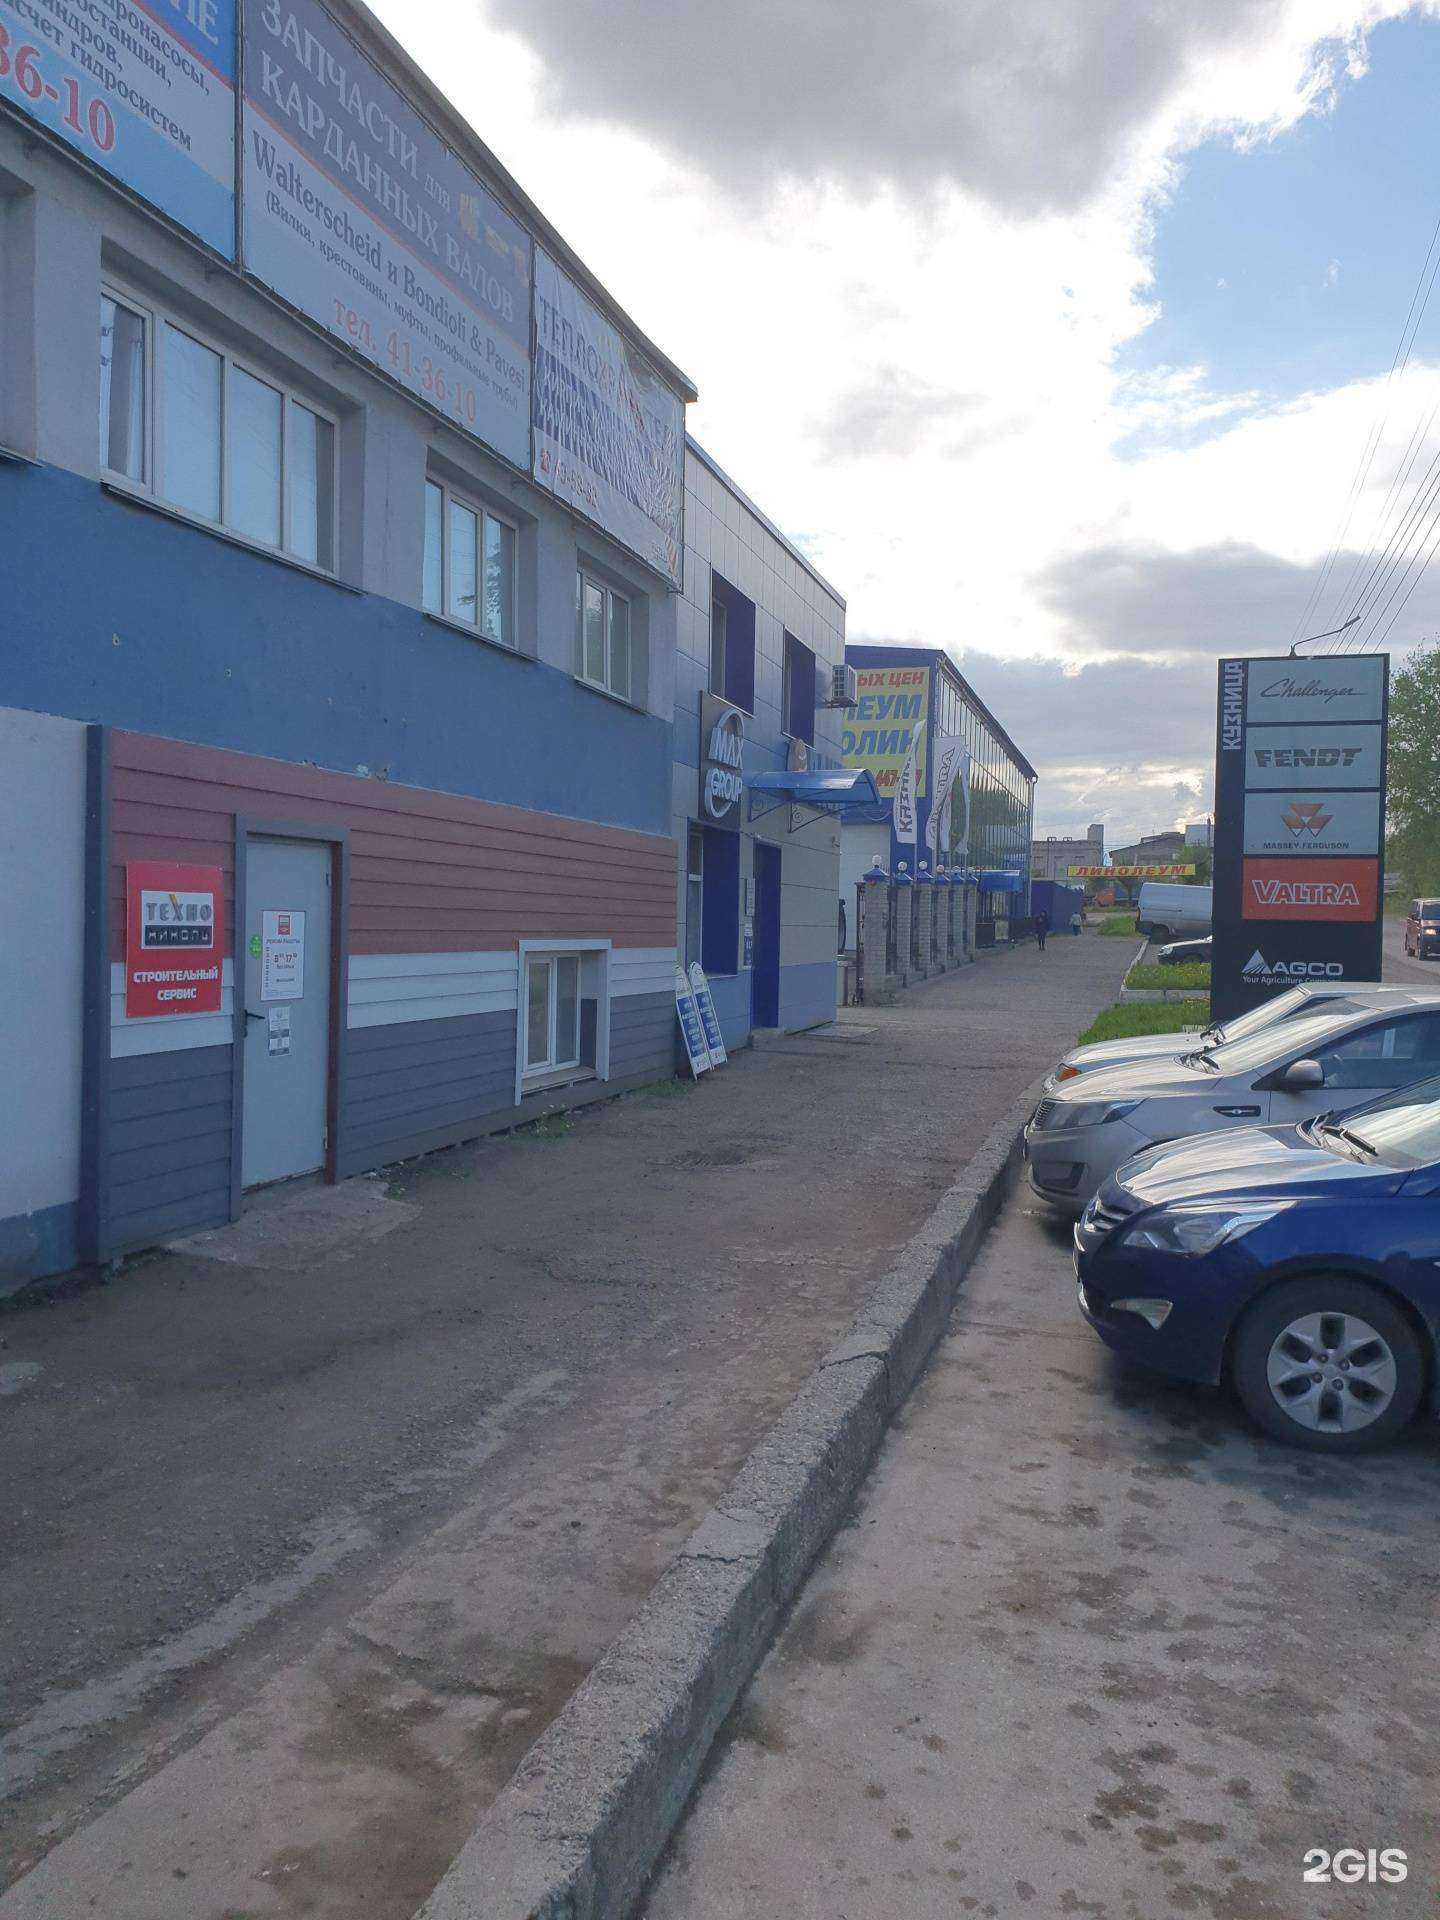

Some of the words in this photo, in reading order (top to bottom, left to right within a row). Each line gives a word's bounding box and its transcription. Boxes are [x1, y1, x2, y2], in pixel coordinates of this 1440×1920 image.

[77, 0, 171, 87] останции,
[70, 39, 191, 151] гидросистем
[261, 0, 418, 181] ЗАПЧАСТИ
[424, 173, 450, 211] для
[262, 50, 439, 256] КАРДАННЫХ
[446, 233, 514, 323] ВАЛОВ
[253, 130, 381, 272] Walterscheid
[404, 265, 466, 344] Bondioli
[470, 326, 483, 356] &
[486, 337, 526, 393] Pavesi
[319, 239, 391, 312] крестовины,
[334, 299, 377, 351] тел.
[387, 330, 476, 423] 41-36-10
[857, 672, 886, 687] ЫХ
[888, 671, 925, 688] ЦЕН
[1260, 678, 1368, 703] Challenger
[1223, 661, 1243, 751] КУЗНИЦА
[709, 727, 744, 769] MAX
[1255, 747, 1362, 768] FENDT
[1075, 864, 1187, 876] ЛИНОЛЕУМ
[1252, 879, 1360, 905] VALTRA
[146, 895, 212, 922] ТЕХНО
[133, 966, 218, 983] СТРОИТЕЛЬНЫЙ
[1242, 976, 1259, 984] Your
[1272, 961, 1344, 976] AGCO
[156, 988, 197, 1001] СЕРВИС
